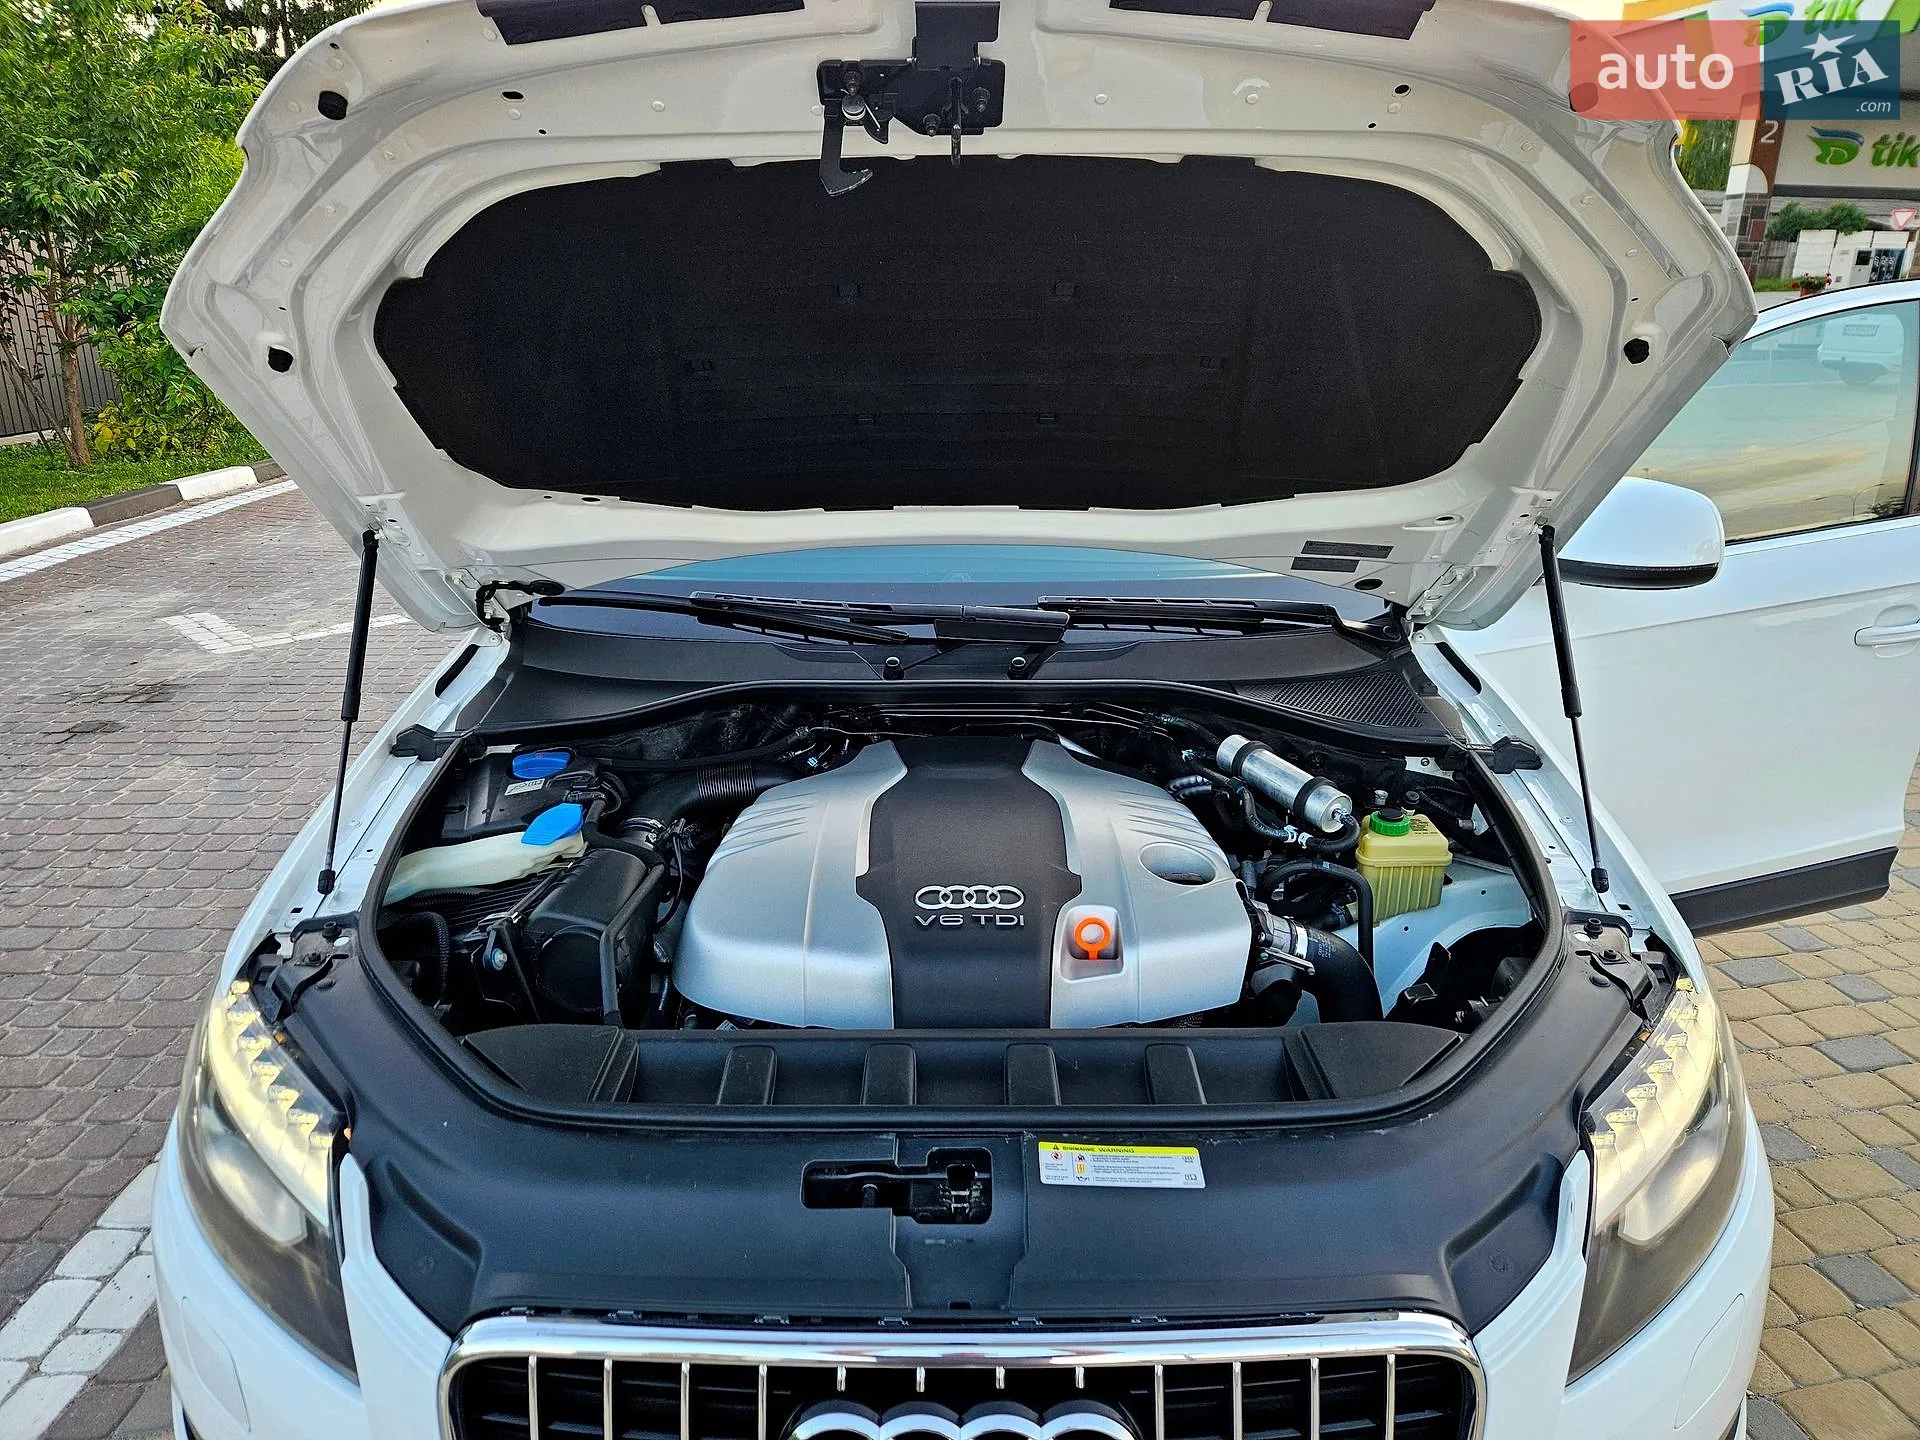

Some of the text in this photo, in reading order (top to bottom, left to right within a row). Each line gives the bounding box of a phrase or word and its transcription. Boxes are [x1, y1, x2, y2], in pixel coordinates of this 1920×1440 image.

[1760, 120, 1779, 143] 2
[1871, 132, 1920, 167] tik
[914, 914, 1025, 926] V6 TDI
